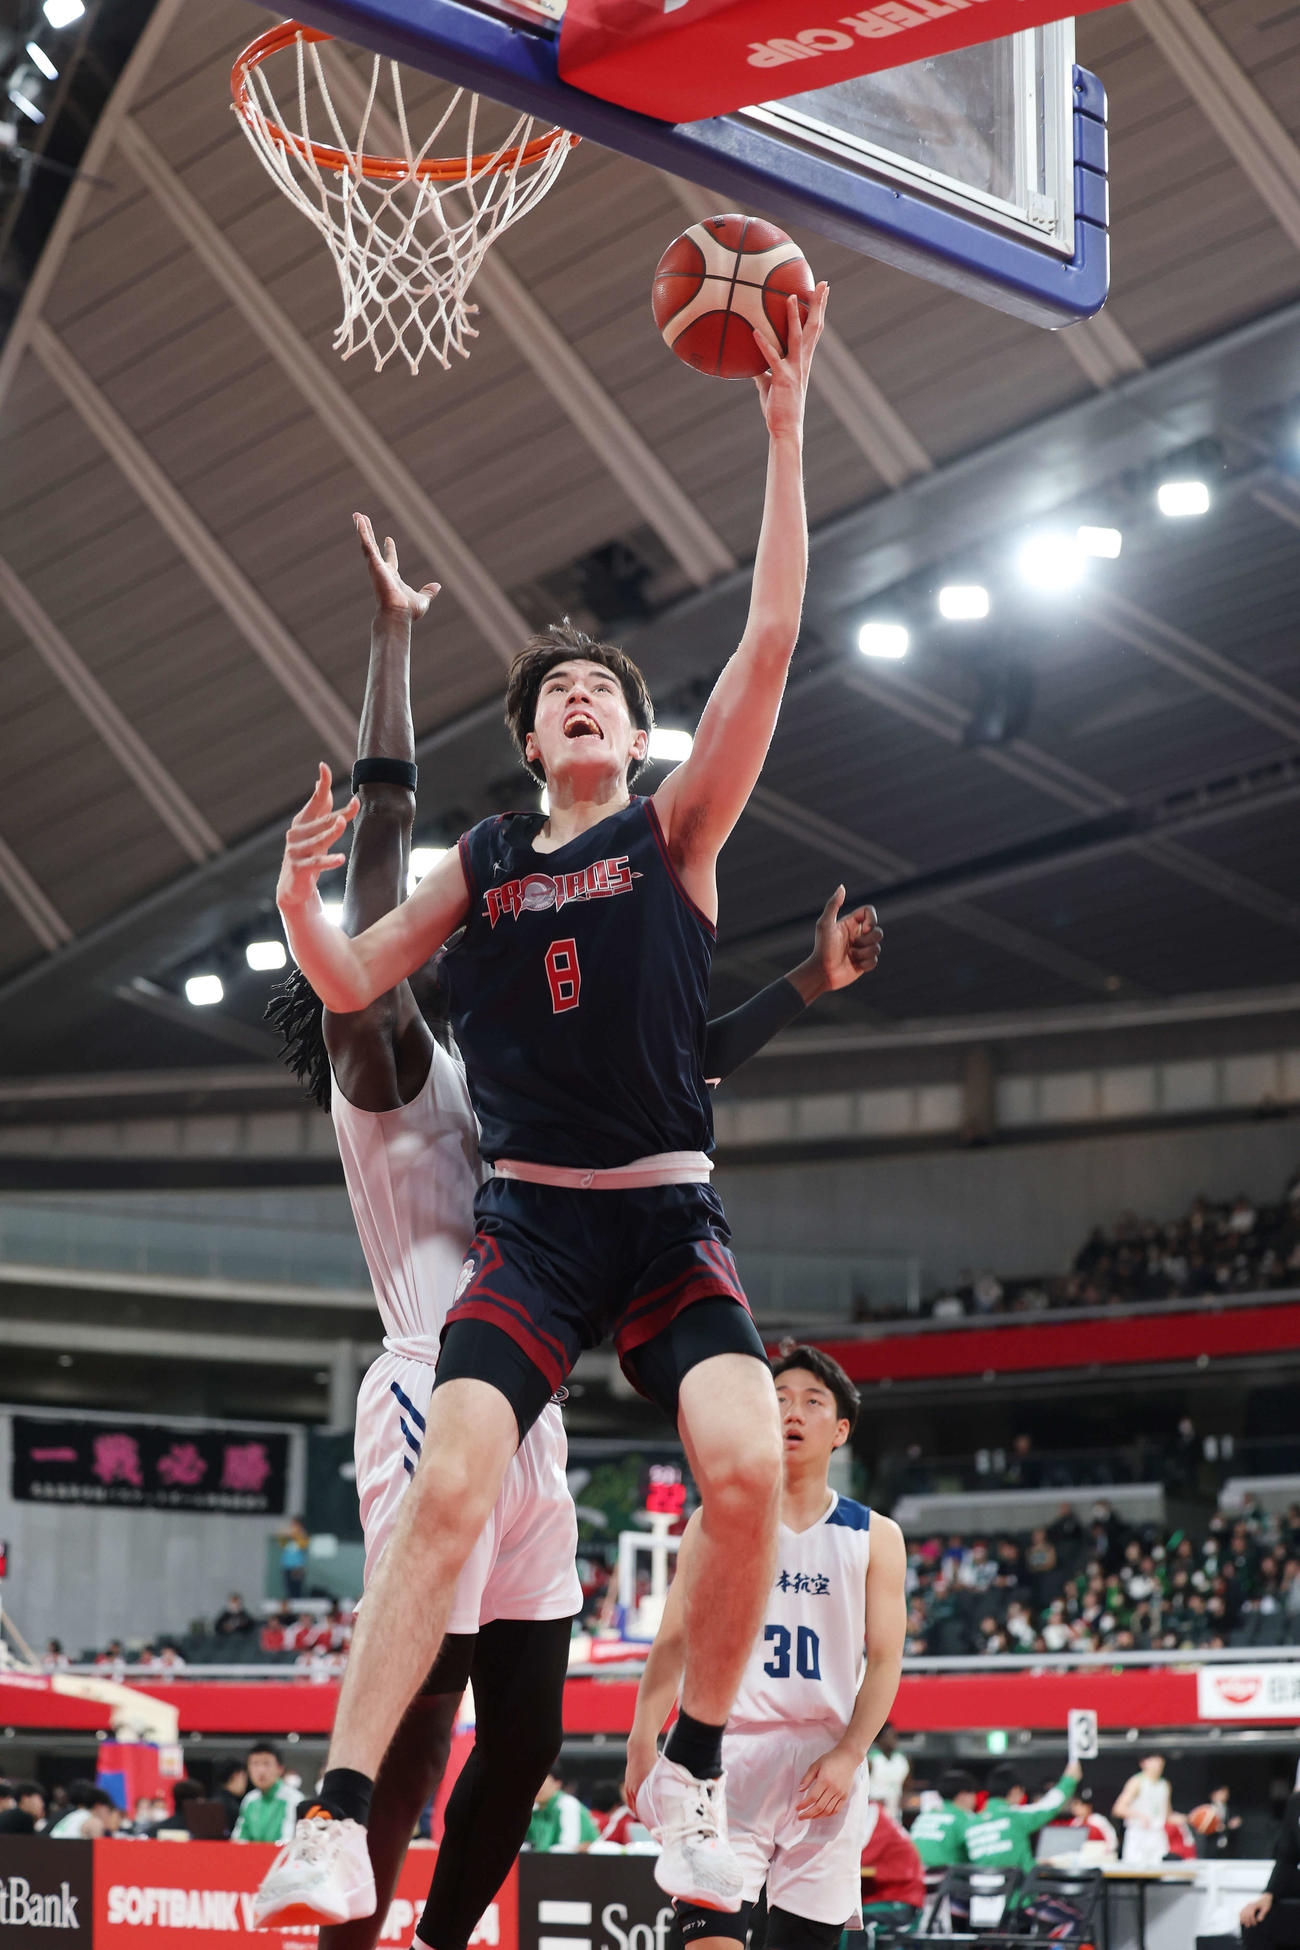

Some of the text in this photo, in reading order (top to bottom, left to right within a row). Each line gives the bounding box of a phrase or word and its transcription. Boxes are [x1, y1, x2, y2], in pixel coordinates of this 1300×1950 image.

[746, 0, 990, 68] TER CUP
[482, 855, 643, 930] TROJANS
[544, 937, 581, 1014] 8
[776, 1569, 831, 1596] 本航空
[764, 1624, 822, 1681] 30
[1076, 1716, 1093, 1752] 3
[0, 1876, 80, 1929] tBank
[108, 1885, 240, 1931] SOFTBANK
[601, 1902, 676, 1950] Sof
